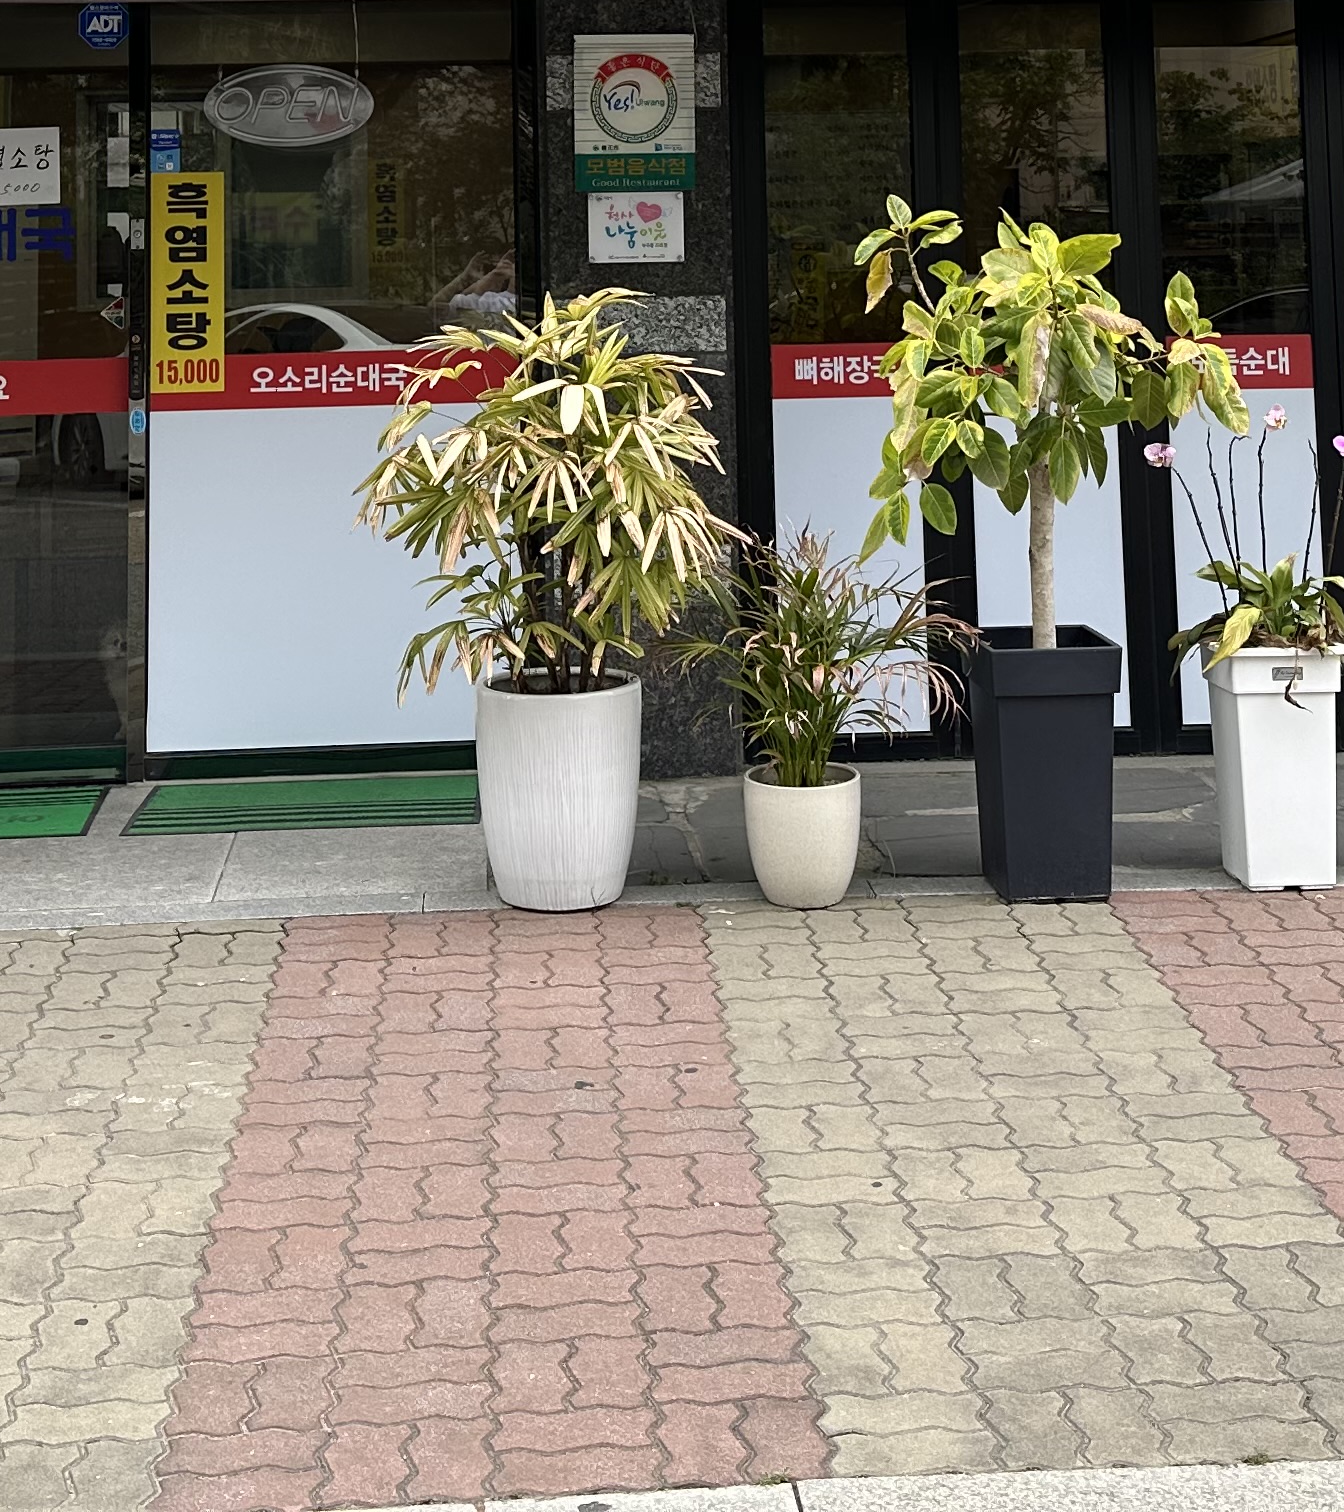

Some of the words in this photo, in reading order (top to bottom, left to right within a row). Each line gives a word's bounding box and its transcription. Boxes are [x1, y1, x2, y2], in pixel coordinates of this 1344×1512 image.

[86, 14, 122, 33] ADT
[214, 85, 359, 124] OPEN
[603, 88, 635, 113] Yes!
[586, 157, 686, 176] 모범음식점
[592, 178, 620, 187] Good
[623, 178, 680, 187] Restaurant
[164, 181, 212, 351] 흑염소탕
[155, 357, 221, 386] 15,000
[250, 363, 408, 394] 오소리순대국
